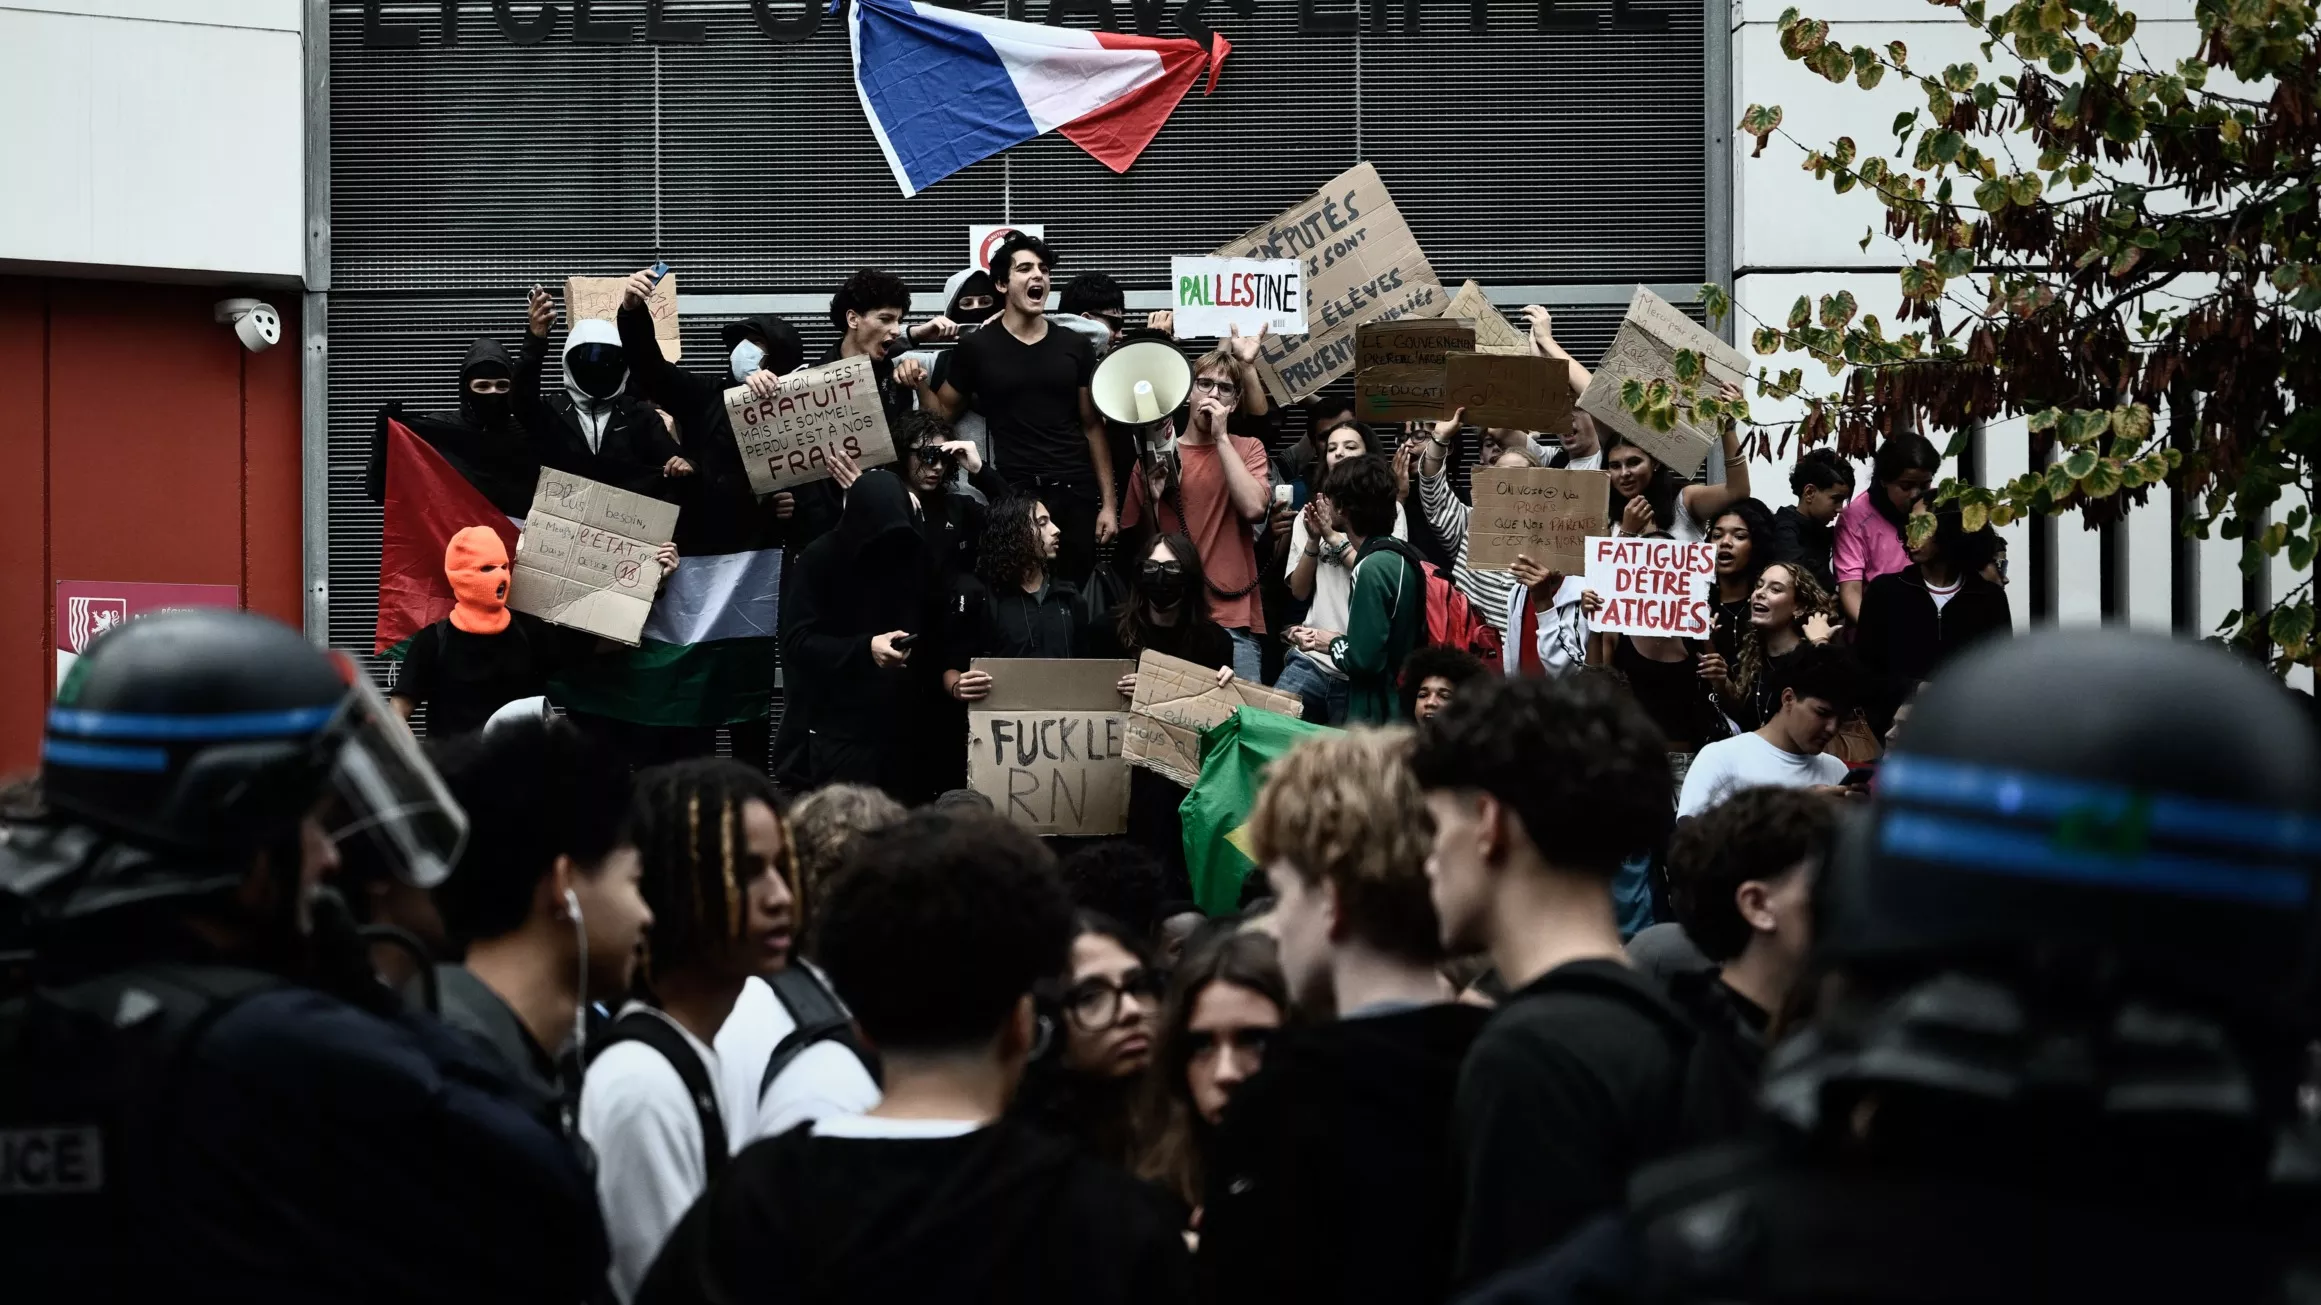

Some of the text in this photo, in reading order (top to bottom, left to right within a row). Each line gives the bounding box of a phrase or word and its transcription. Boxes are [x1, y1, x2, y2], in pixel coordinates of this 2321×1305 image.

[1325, 228, 1366, 268] SONT
[1179, 272, 1298, 313] PALLESTINE
[1320, 268, 1403, 327] ÉLÈVES
[1362, 335, 1386, 349] LE
[823, 363, 862, 384] C'EST
[1365, 384, 1445, 398] L'EDUCATI
[740, 425, 772, 444] MAIS
[777, 419, 793, 434] LE
[745, 416, 874, 459] PERDU EST À NOS
[544, 481, 585, 513] Plus
[1494, 518, 1520, 530] QUE
[1549, 516, 1597, 532] PARENTS
[1529, 534, 1551, 547] PAS
[1597, 541, 1714, 574] FATIGUÉS
[1615, 565, 1691, 596] D'ÊTRE
[990, 716, 1080, 767] FUCK
[1086, 718, 1122, 761] LE
[1007, 767, 1087, 828] RN
